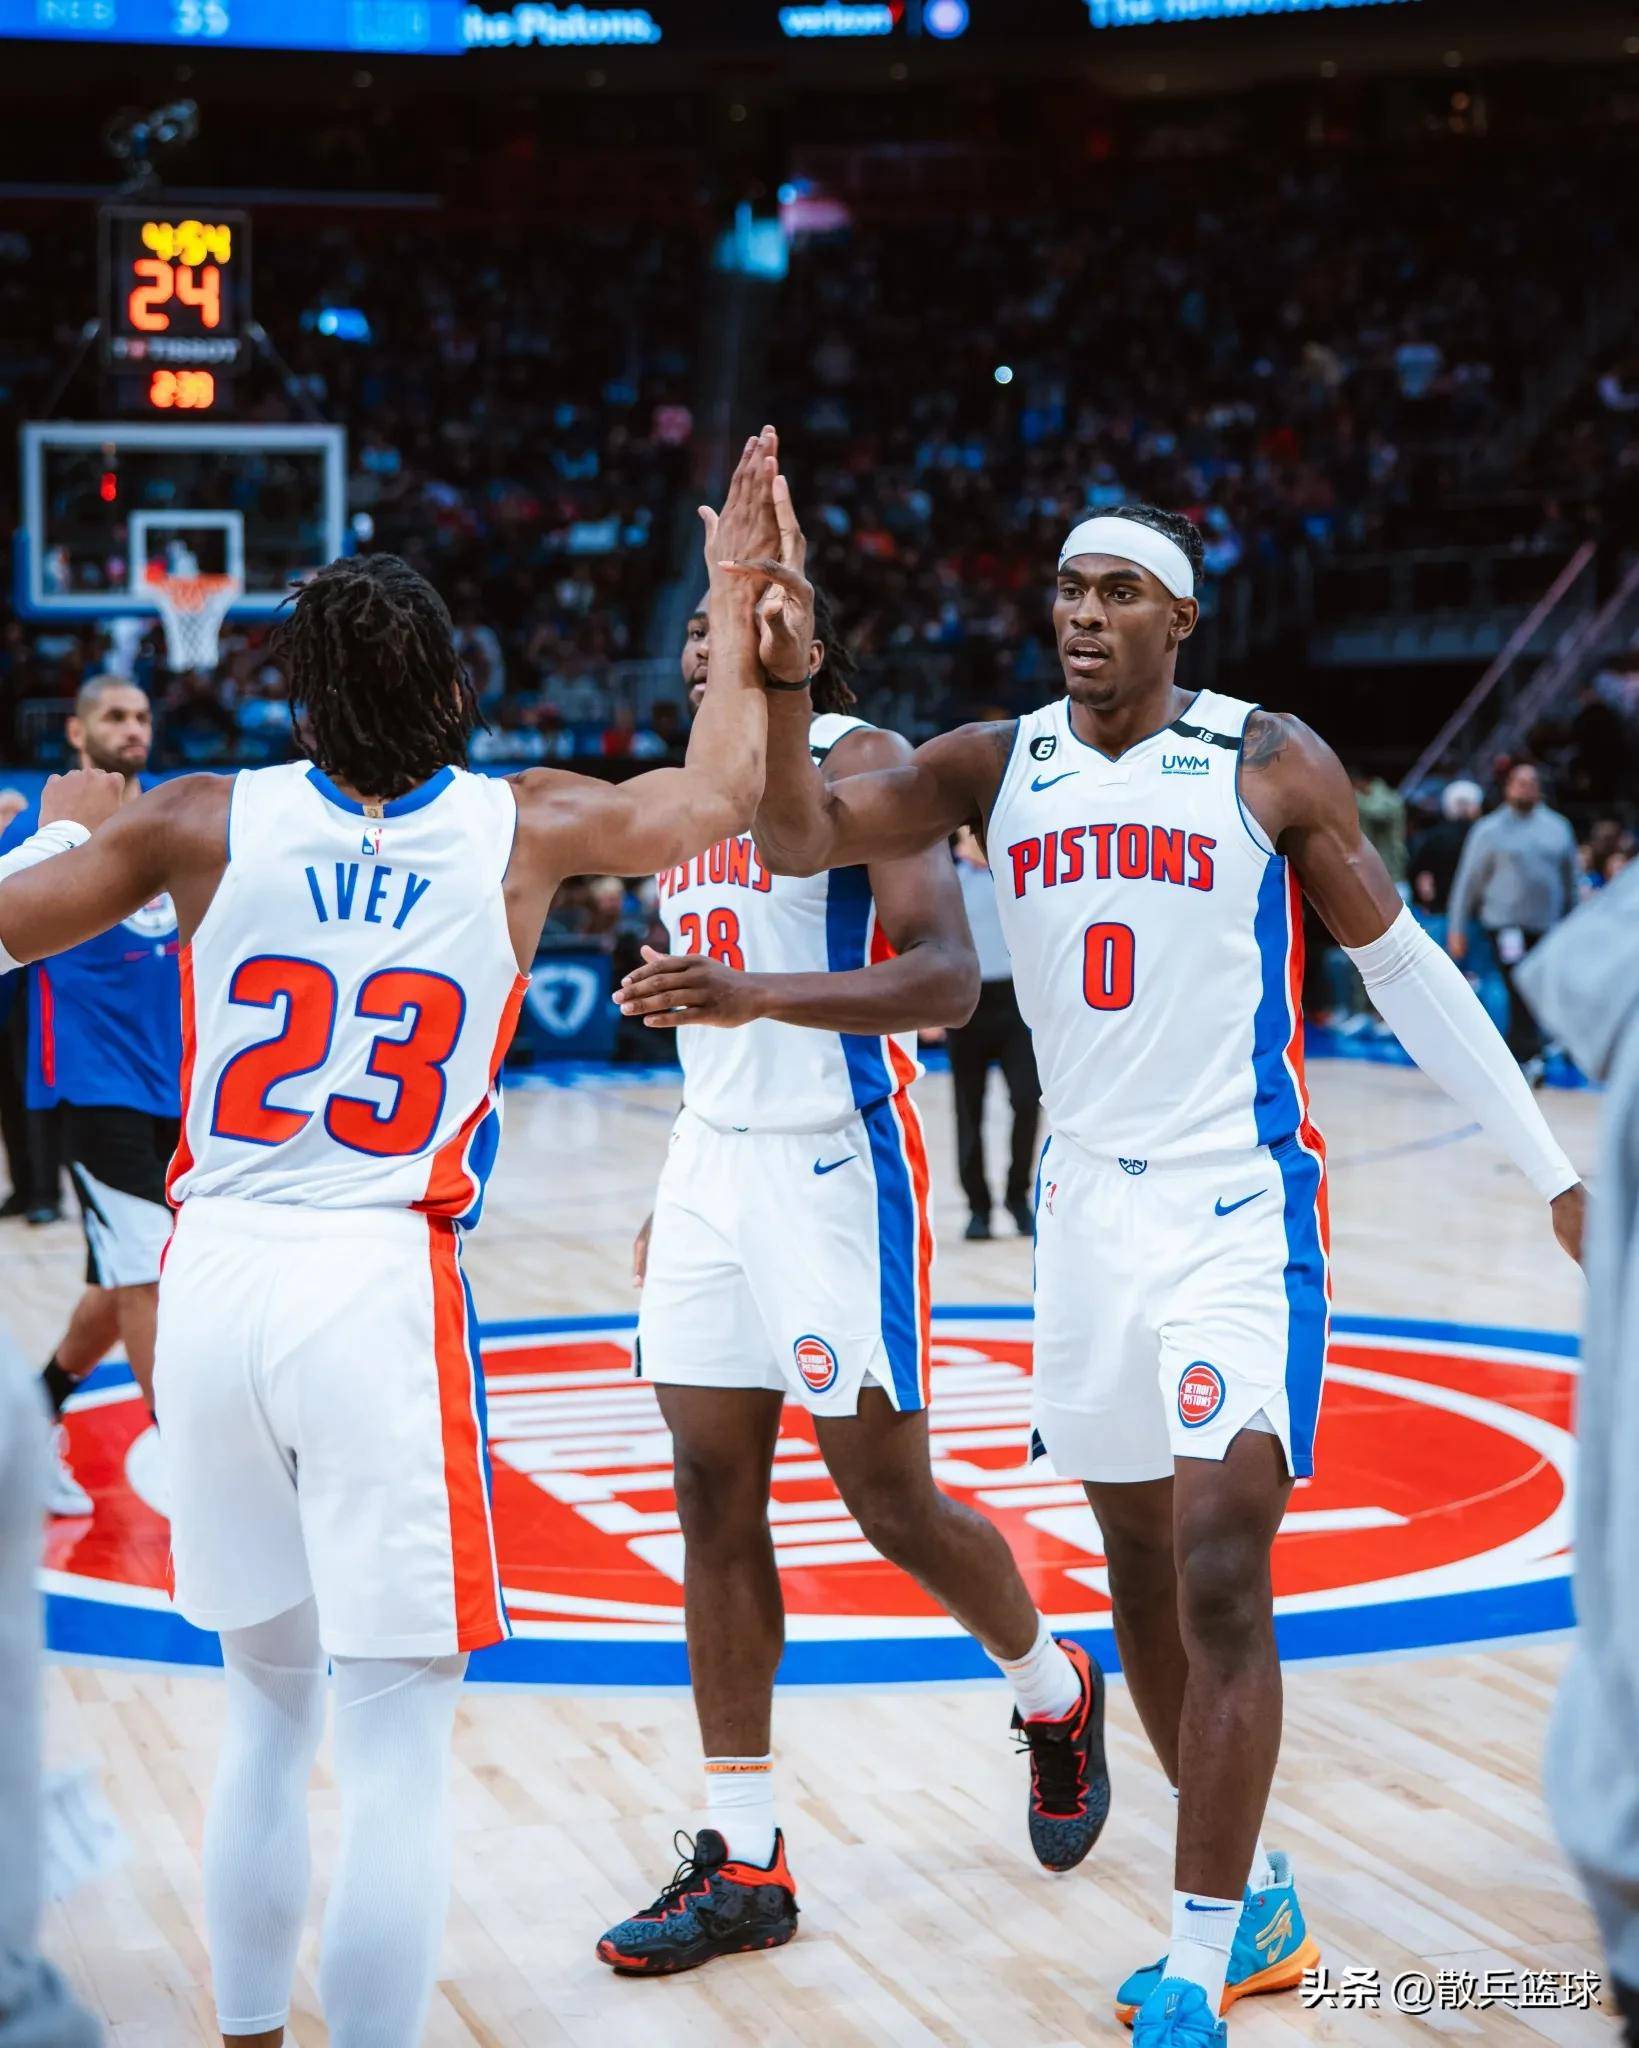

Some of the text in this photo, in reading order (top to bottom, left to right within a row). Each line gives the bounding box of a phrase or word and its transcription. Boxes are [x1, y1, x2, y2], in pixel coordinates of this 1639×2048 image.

[129, 259, 220, 330] 24
[1162, 754, 1209, 770] UWM
[1008, 823, 1217, 899] PISTONS
[305, 862, 431, 930] IVEY
[1083, 922, 1135, 1011] 0
[210, 953, 467, 1158] 23
[1182, 1394, 1213, 1407] PISTONS
[1184, 1383, 1214, 1396] DETROIT
